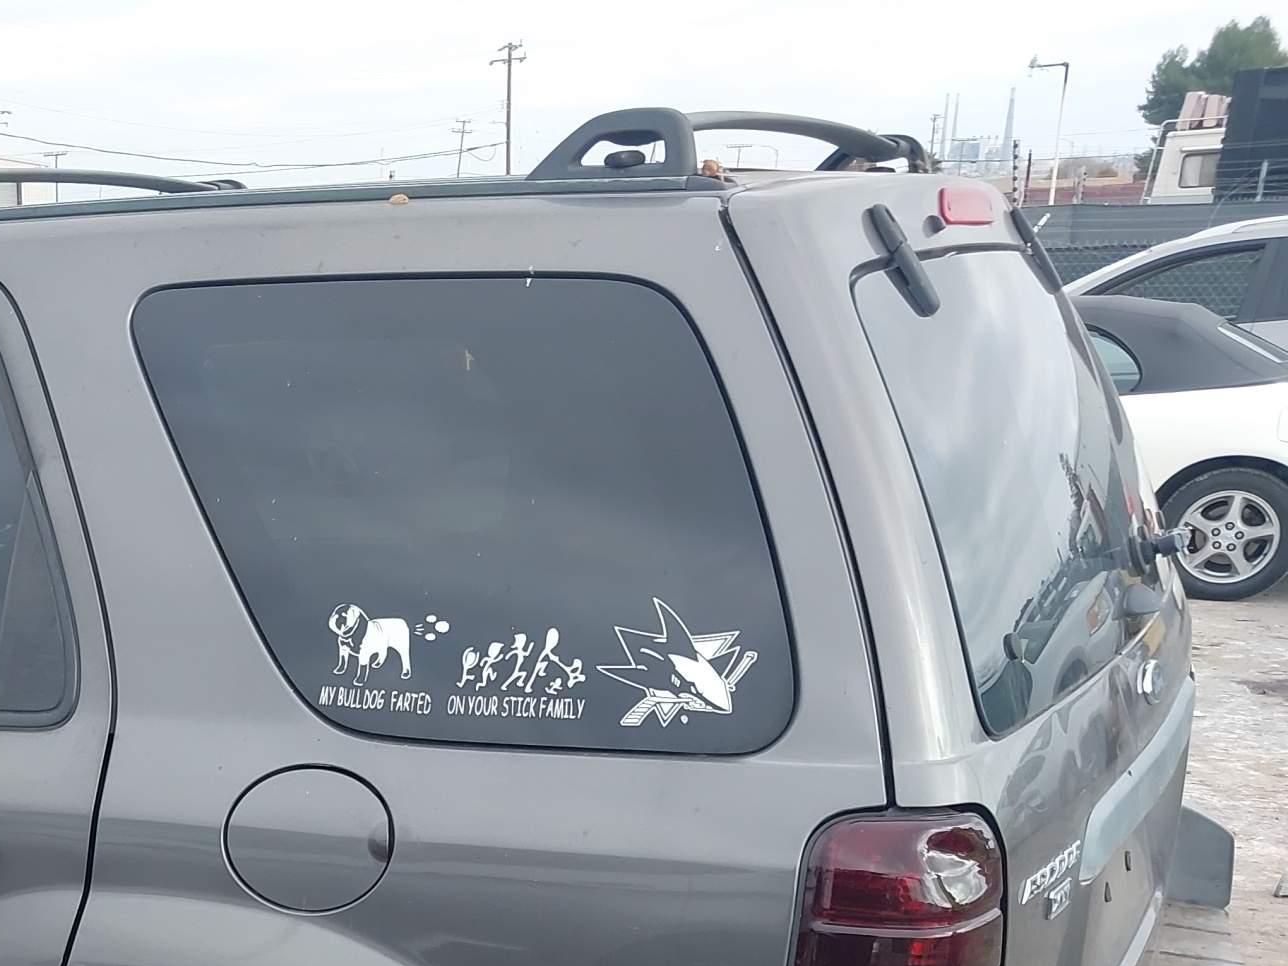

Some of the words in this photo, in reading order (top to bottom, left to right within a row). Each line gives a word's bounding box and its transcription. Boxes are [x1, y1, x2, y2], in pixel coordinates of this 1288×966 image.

[319, 687, 334, 705] MY
[338, 687, 385, 709] BULLDOG
[391, 691, 431, 714] FARTED
[448, 696, 465, 714] ON
[469, 696, 497, 715] YOUR
[502, 697, 536, 717] STICK
[539, 697, 584, 718] FAMILY
